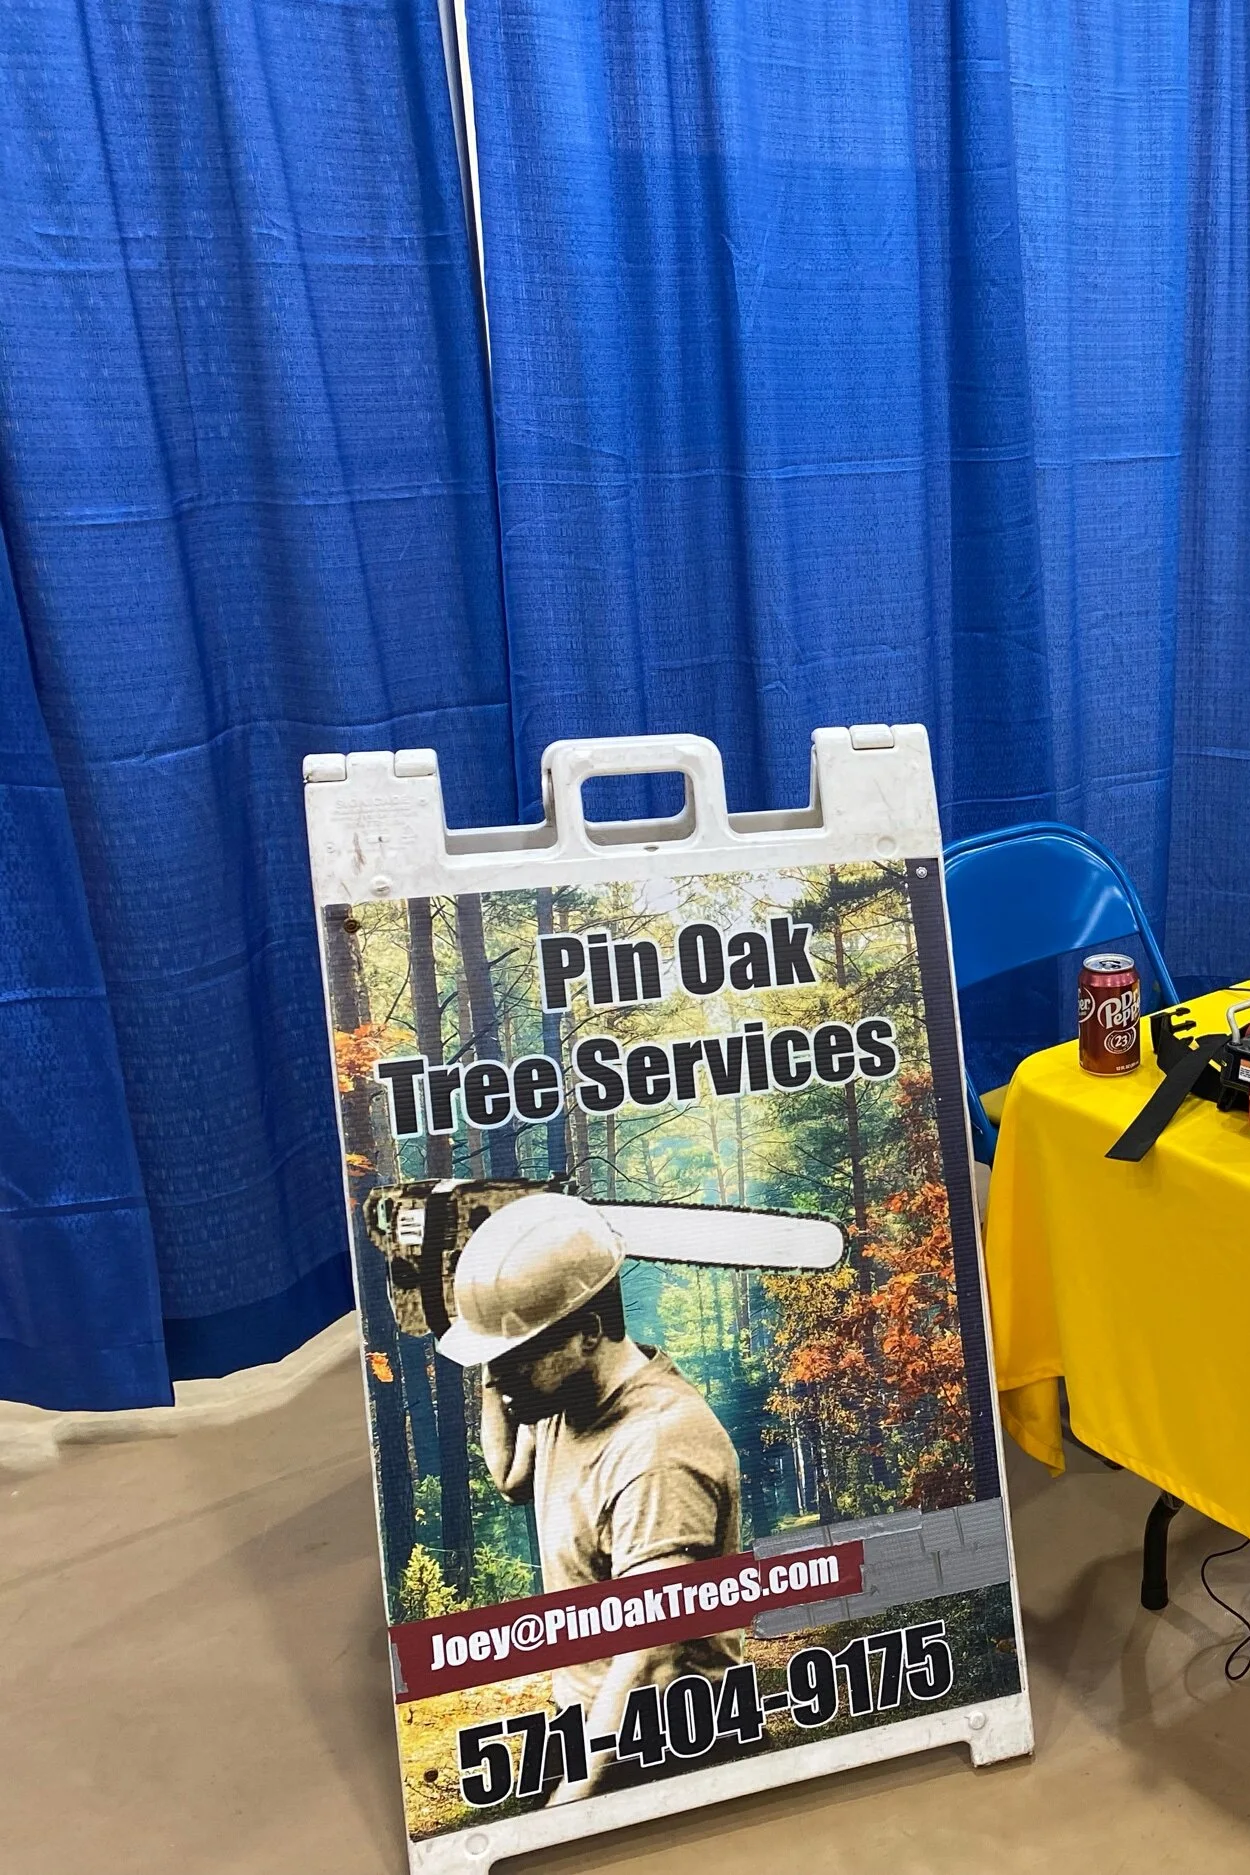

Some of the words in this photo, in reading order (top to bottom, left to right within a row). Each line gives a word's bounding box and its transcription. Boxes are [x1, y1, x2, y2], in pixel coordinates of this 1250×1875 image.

[537, 931, 667, 1013] Pin
[676, 914, 816, 998] Oak
[376, 1055, 565, 1138] Tree
[571, 1017, 900, 1116] Services
[1114, 1034, 1128, 1048] 23
[429, 1553, 840, 1672] Joey@PinOakTreeS.com
[456, 1620, 953, 1808] 571-404-9175
